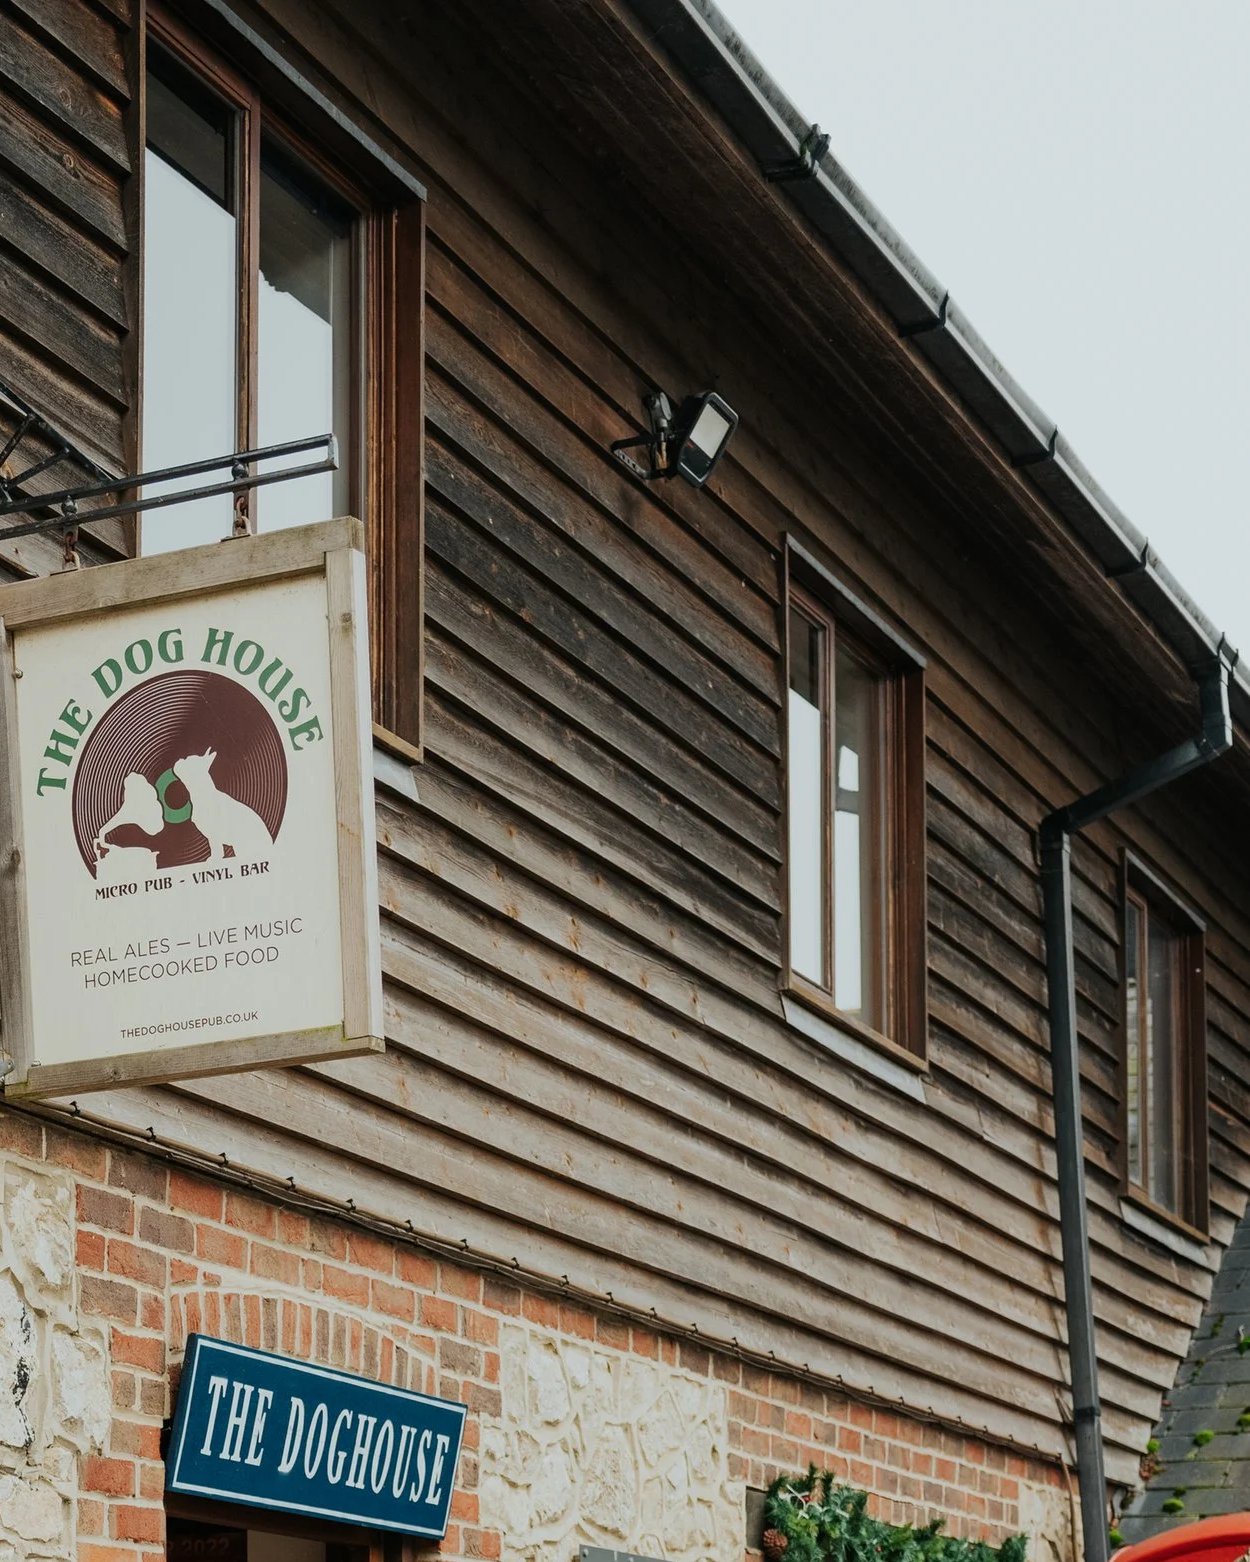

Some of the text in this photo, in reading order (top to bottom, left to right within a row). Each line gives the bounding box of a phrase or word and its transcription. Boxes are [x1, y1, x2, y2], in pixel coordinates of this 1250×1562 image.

[37, 627, 323, 797] THE DOG HOUSE
[95, 882, 138, 900] MICRO
[145, 877, 173, 892] PUB
[193, 867, 234, 884] VINYL
[240, 861, 270, 877] BAR
[71, 947, 118, 968] REAL
[124, 937, 170, 959] ALES
[198, 928, 237, 949] LIVE
[244, 917, 303, 940] MUSIC
[85, 946, 280, 989] HOMECOOKED FOOD
[120, 1012, 258, 1039] THEDOGHOUSEPUB.CO.UK
[200, 1375, 450, 1506] THE DOGHOUSE
